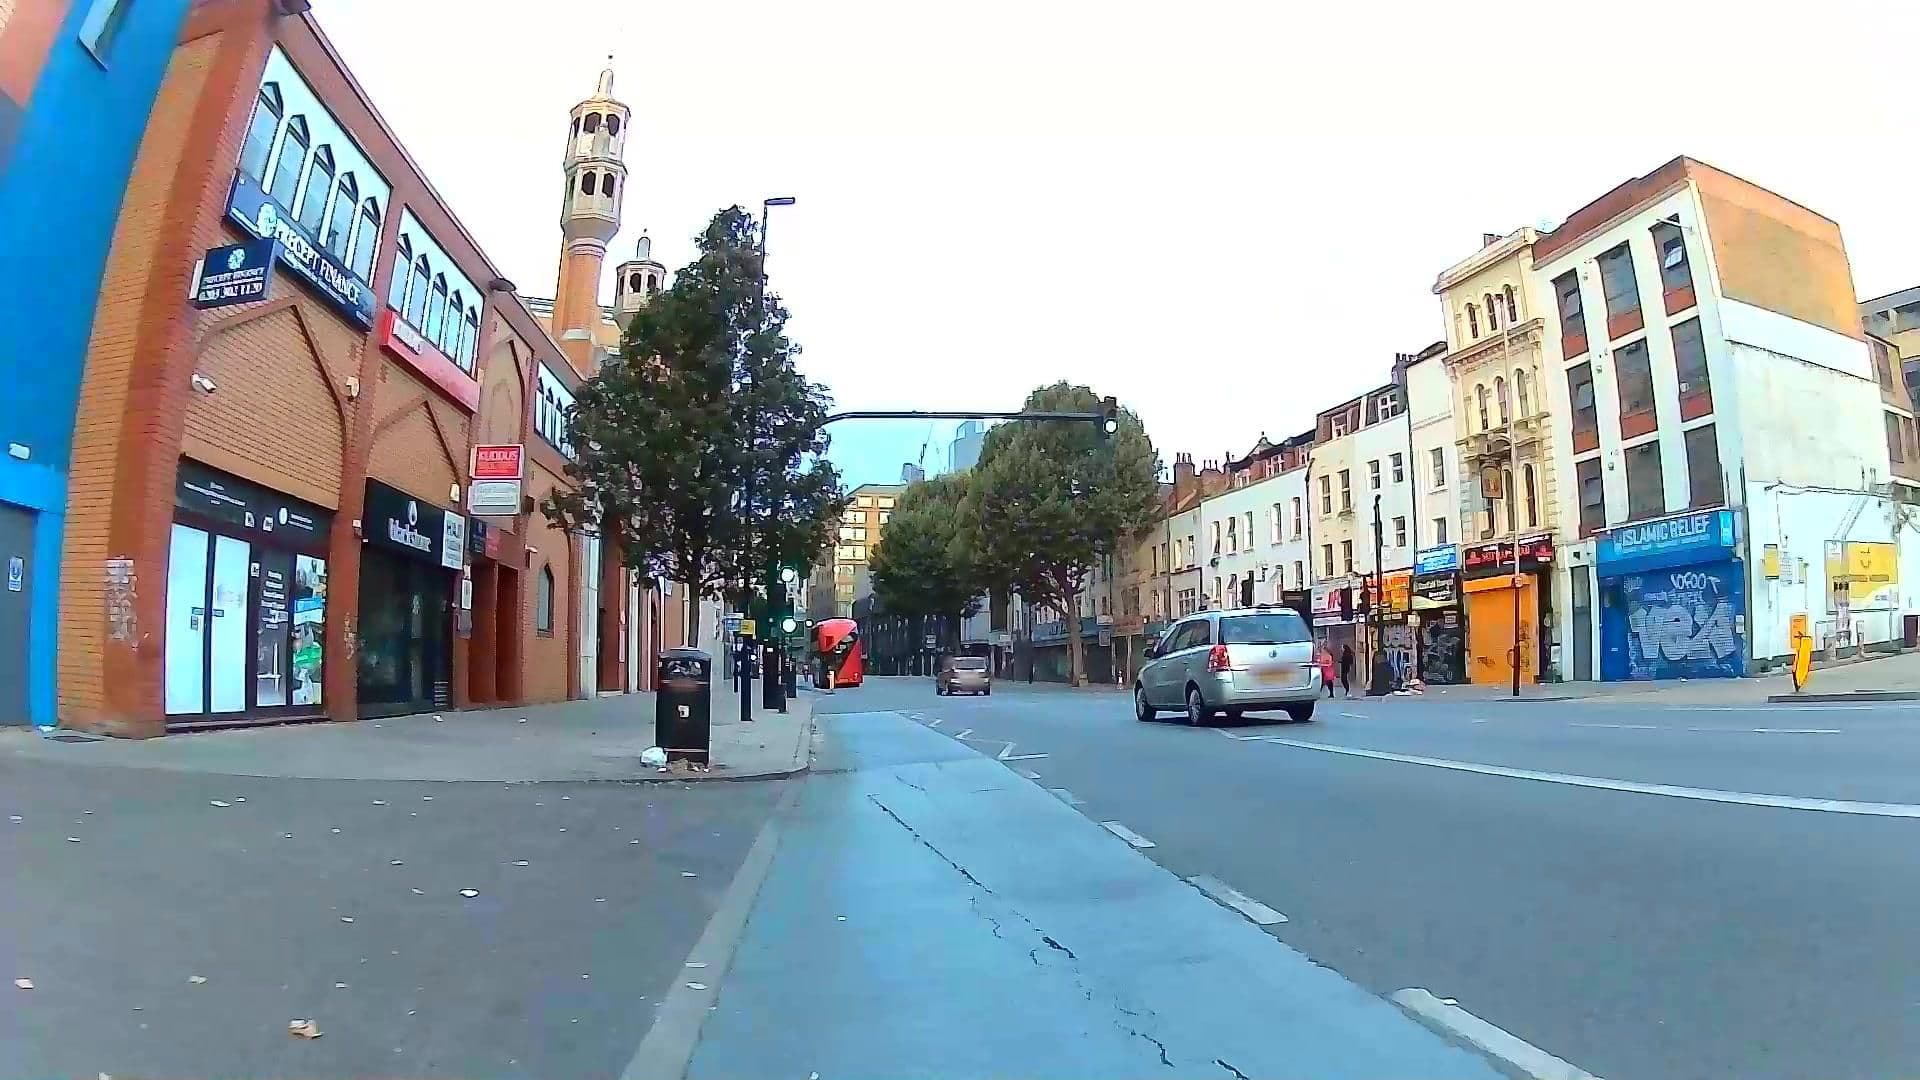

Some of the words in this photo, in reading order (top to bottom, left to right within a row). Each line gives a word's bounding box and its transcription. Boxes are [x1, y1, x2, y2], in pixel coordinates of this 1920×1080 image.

[274, 217, 321, 269] PRECEPT
[319, 258, 362, 305] FINANCE
[1622, 522, 1669, 546] ISLAMIC
